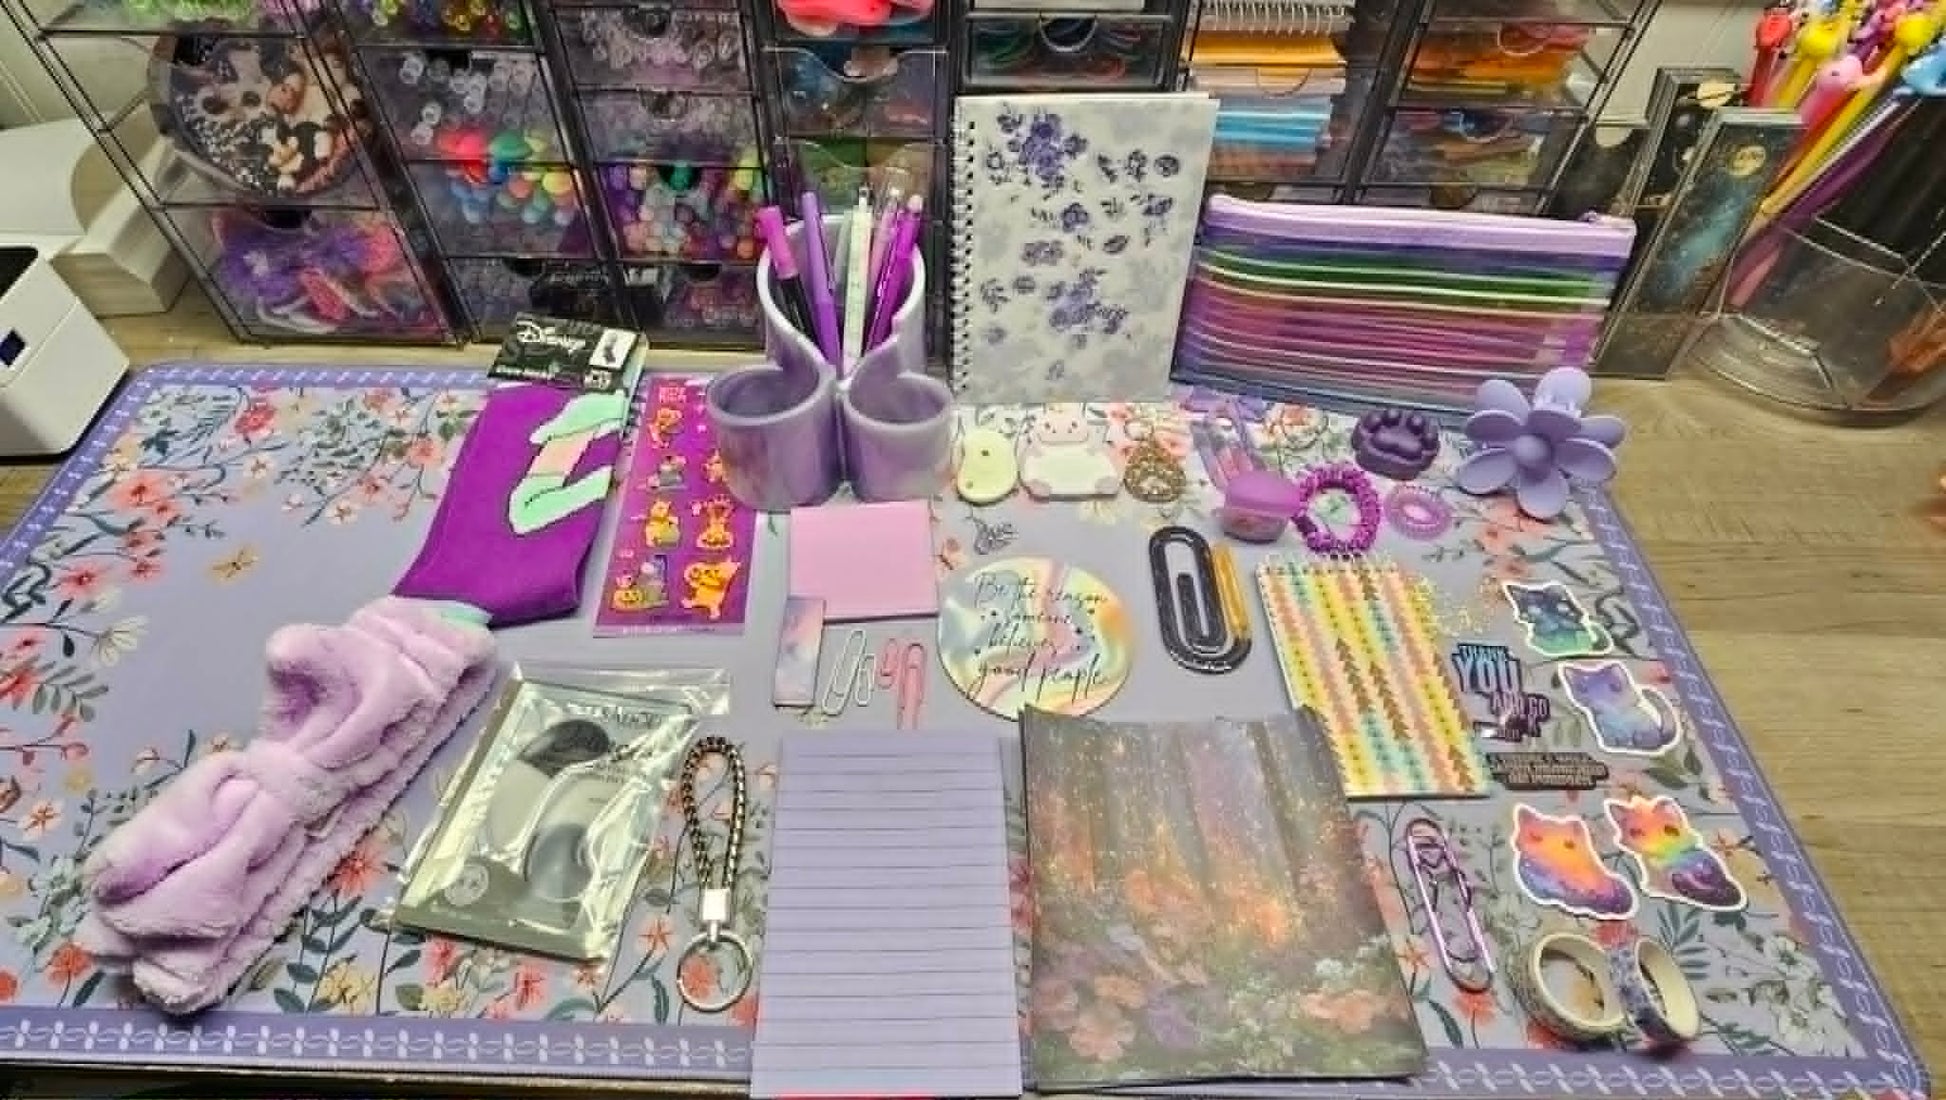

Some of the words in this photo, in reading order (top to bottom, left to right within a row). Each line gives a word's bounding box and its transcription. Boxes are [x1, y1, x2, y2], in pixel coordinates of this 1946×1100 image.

[974, 571, 1008, 607] Be
[966, 650, 1037, 700] good
[1035, 653, 1110, 705] people
[1453, 655, 1520, 693] YOU
